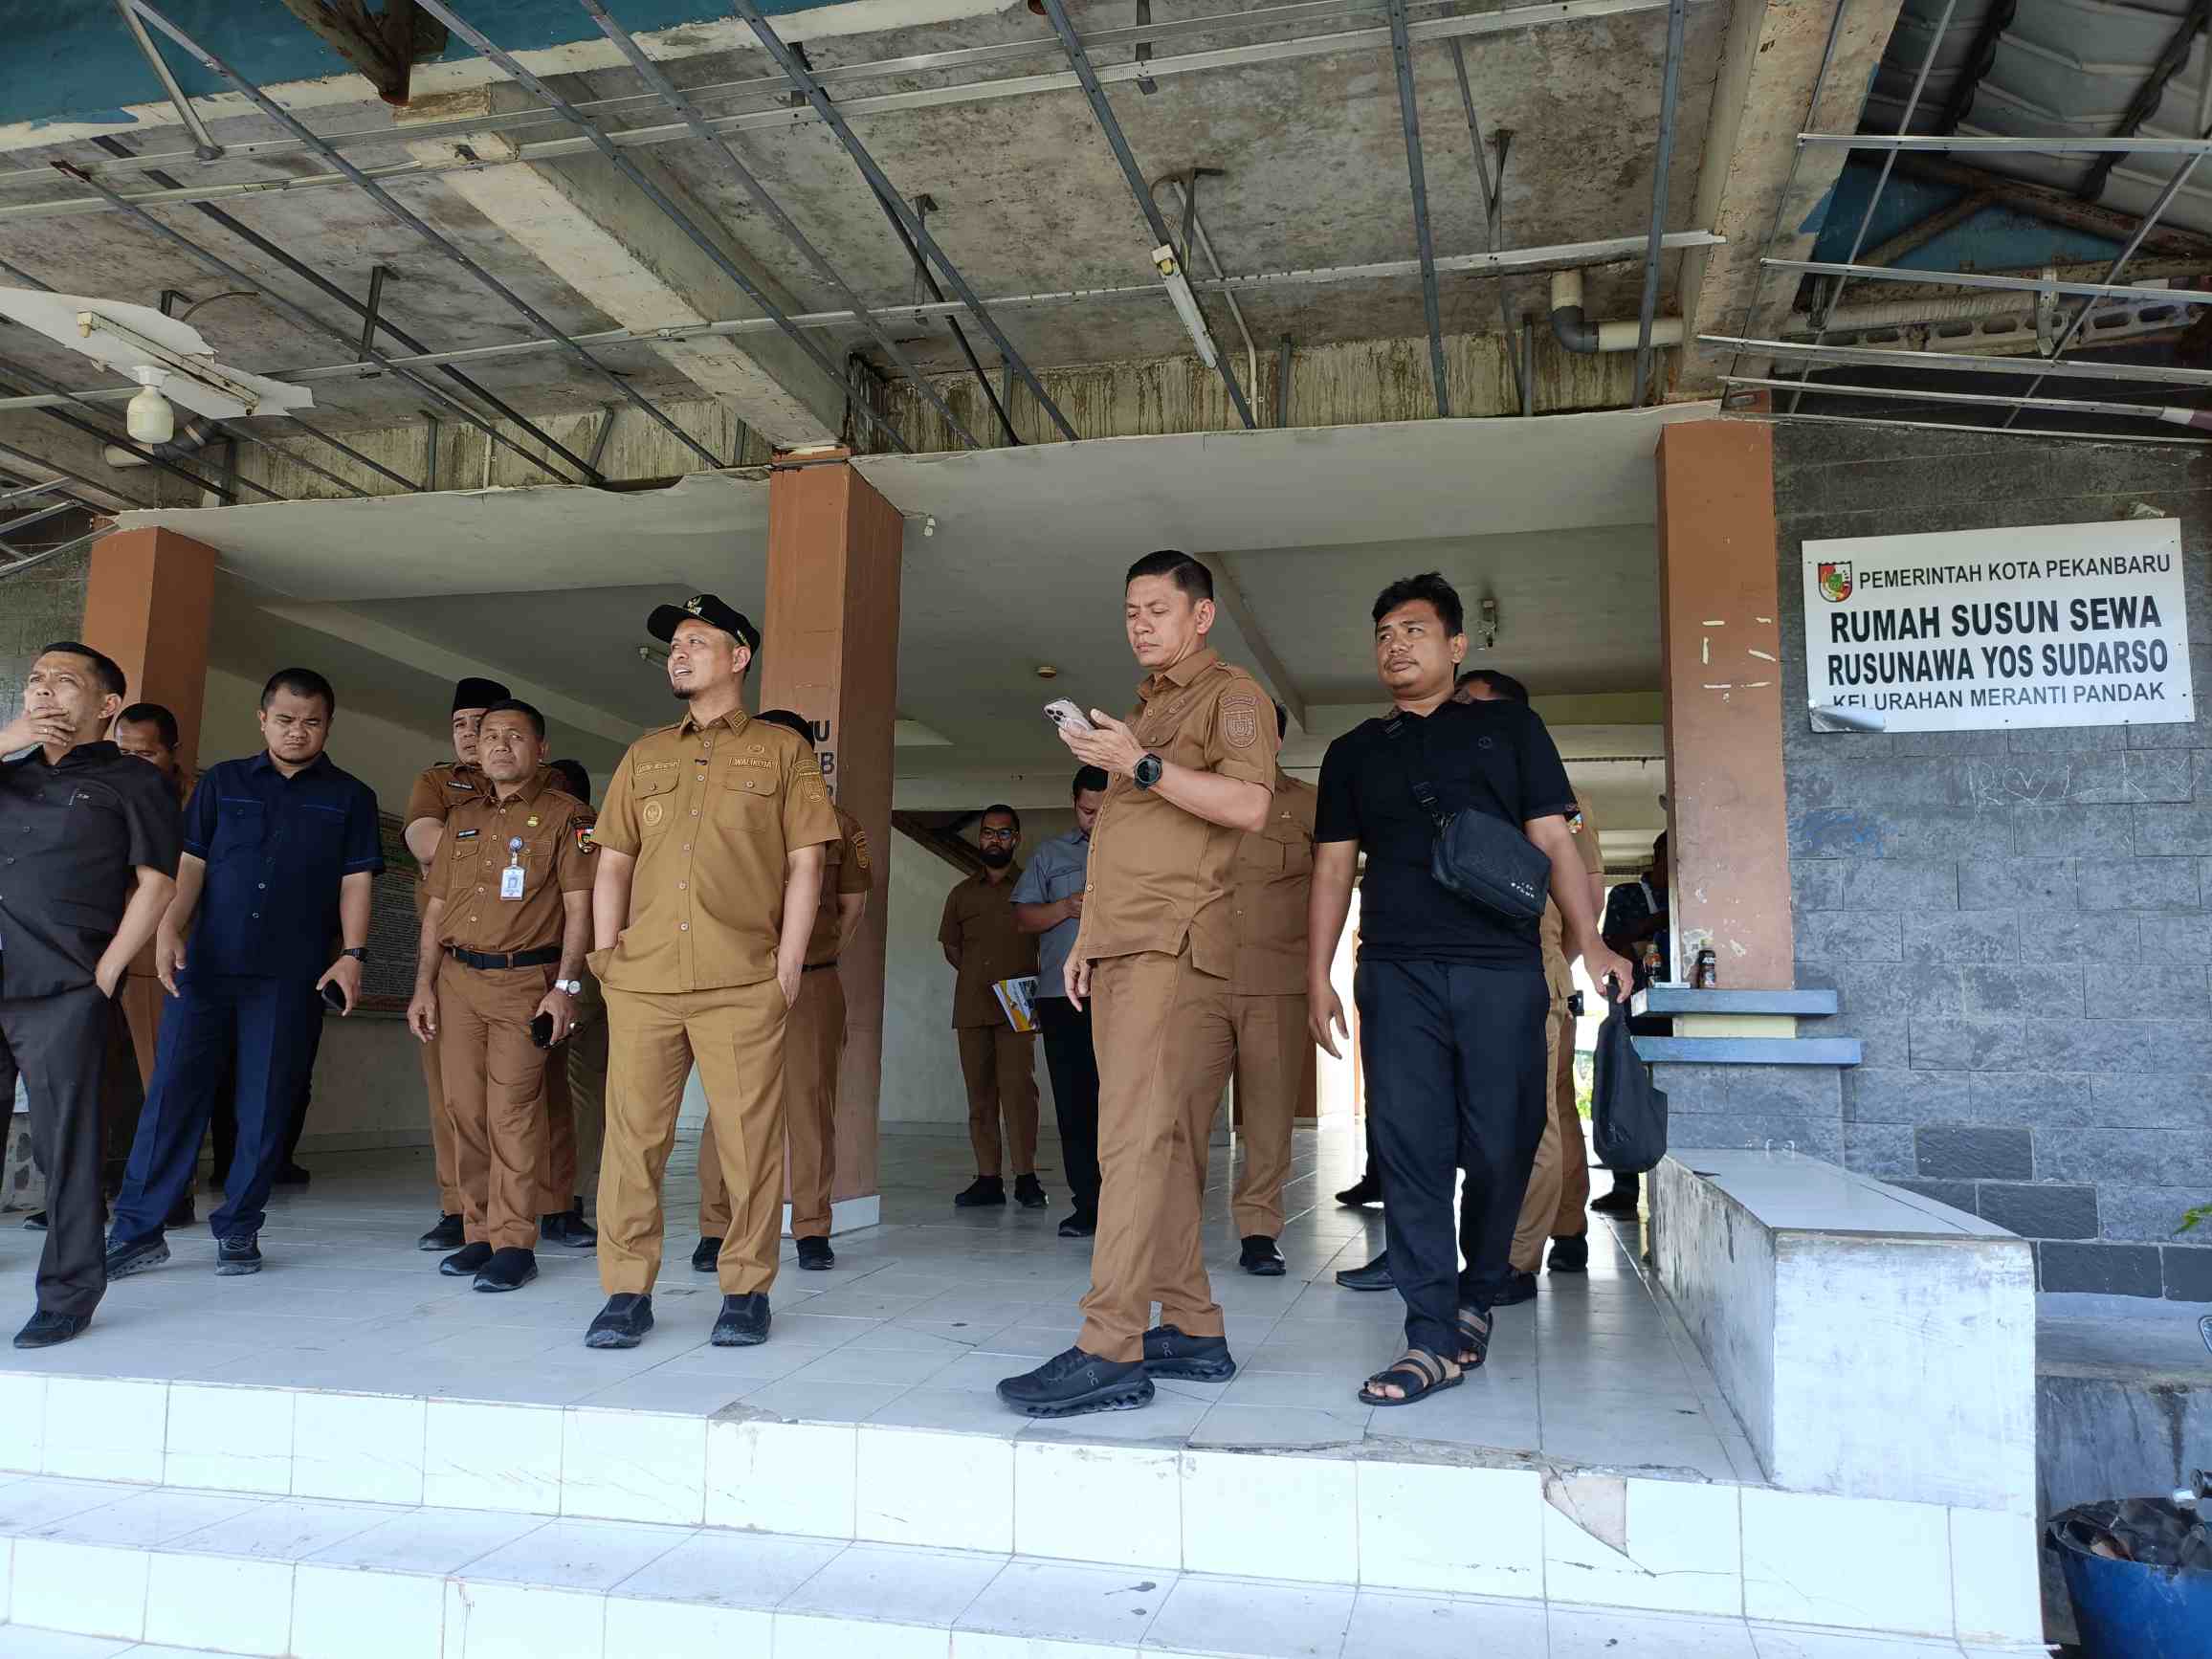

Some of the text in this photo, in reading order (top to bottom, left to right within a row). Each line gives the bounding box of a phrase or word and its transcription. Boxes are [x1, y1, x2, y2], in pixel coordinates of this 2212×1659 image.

[1859, 554, 2171, 589] PEMERINTAH KOTA PEKANBARU
[1830, 595, 2162, 644] RUMAH SUSUN SEWA
[1828, 638, 2168, 686] RUSUNAWA YOS SUDARSO
[1970, 685, 2067, 708] MERANTI
[2073, 681, 2165, 703] PANDAK
